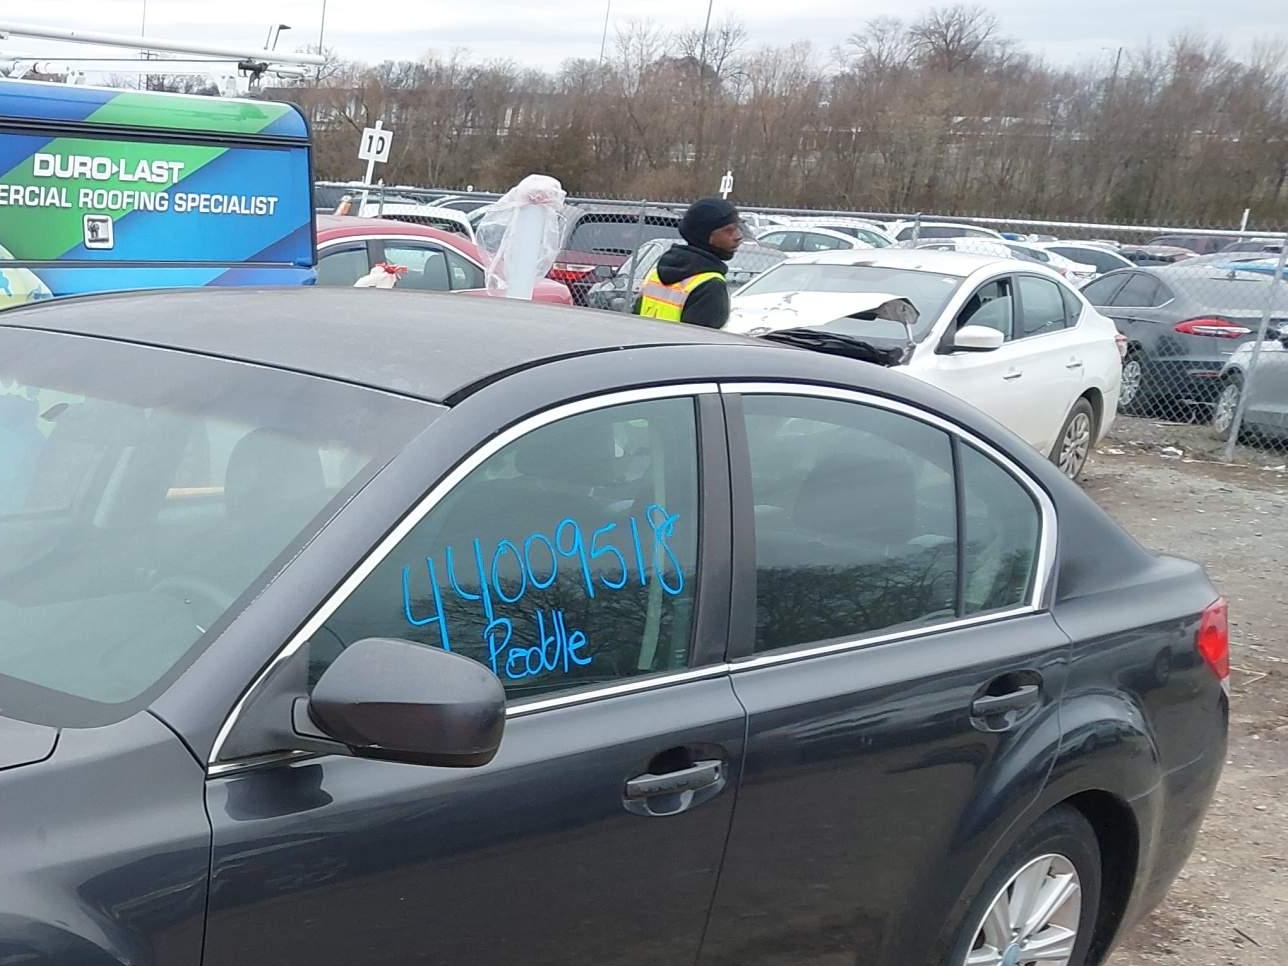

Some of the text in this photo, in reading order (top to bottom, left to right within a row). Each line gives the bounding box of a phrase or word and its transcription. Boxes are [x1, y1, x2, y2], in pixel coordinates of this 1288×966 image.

[78, 187, 170, 212] ROOFING
[174, 193, 279, 216] SPECIALIST
[402, 504, 685, 651] 44009518
